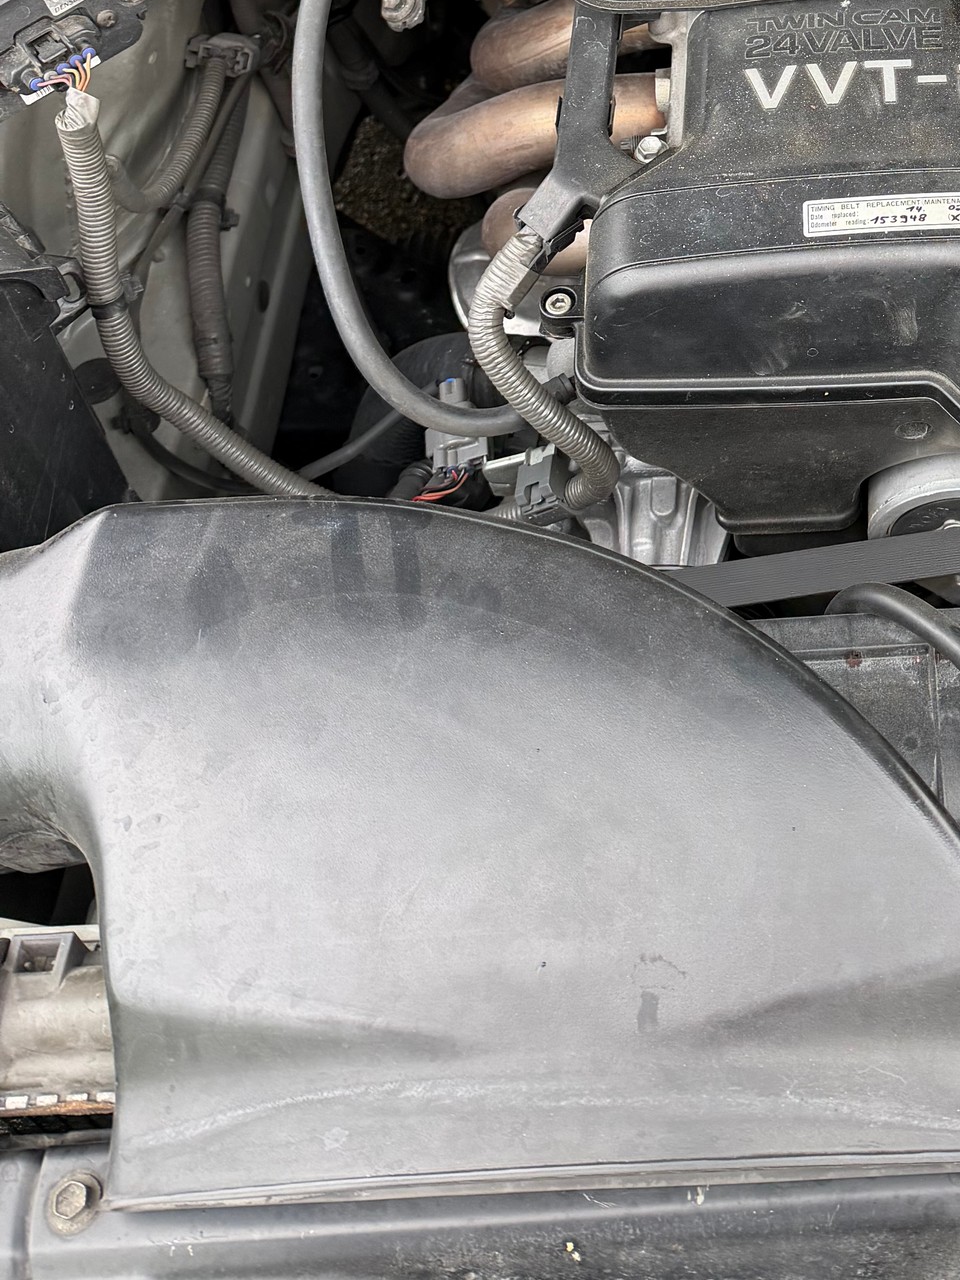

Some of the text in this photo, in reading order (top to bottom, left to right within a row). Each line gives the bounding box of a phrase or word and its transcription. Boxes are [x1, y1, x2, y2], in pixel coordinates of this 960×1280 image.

[746, 7, 942, 34] TWIN CAM
[811, 205, 835, 213] TIMING
[841, 202, 860, 210] BELT
[866, 199, 920, 208] REPLACEMENT
[810, 221, 837, 229] Odometer
